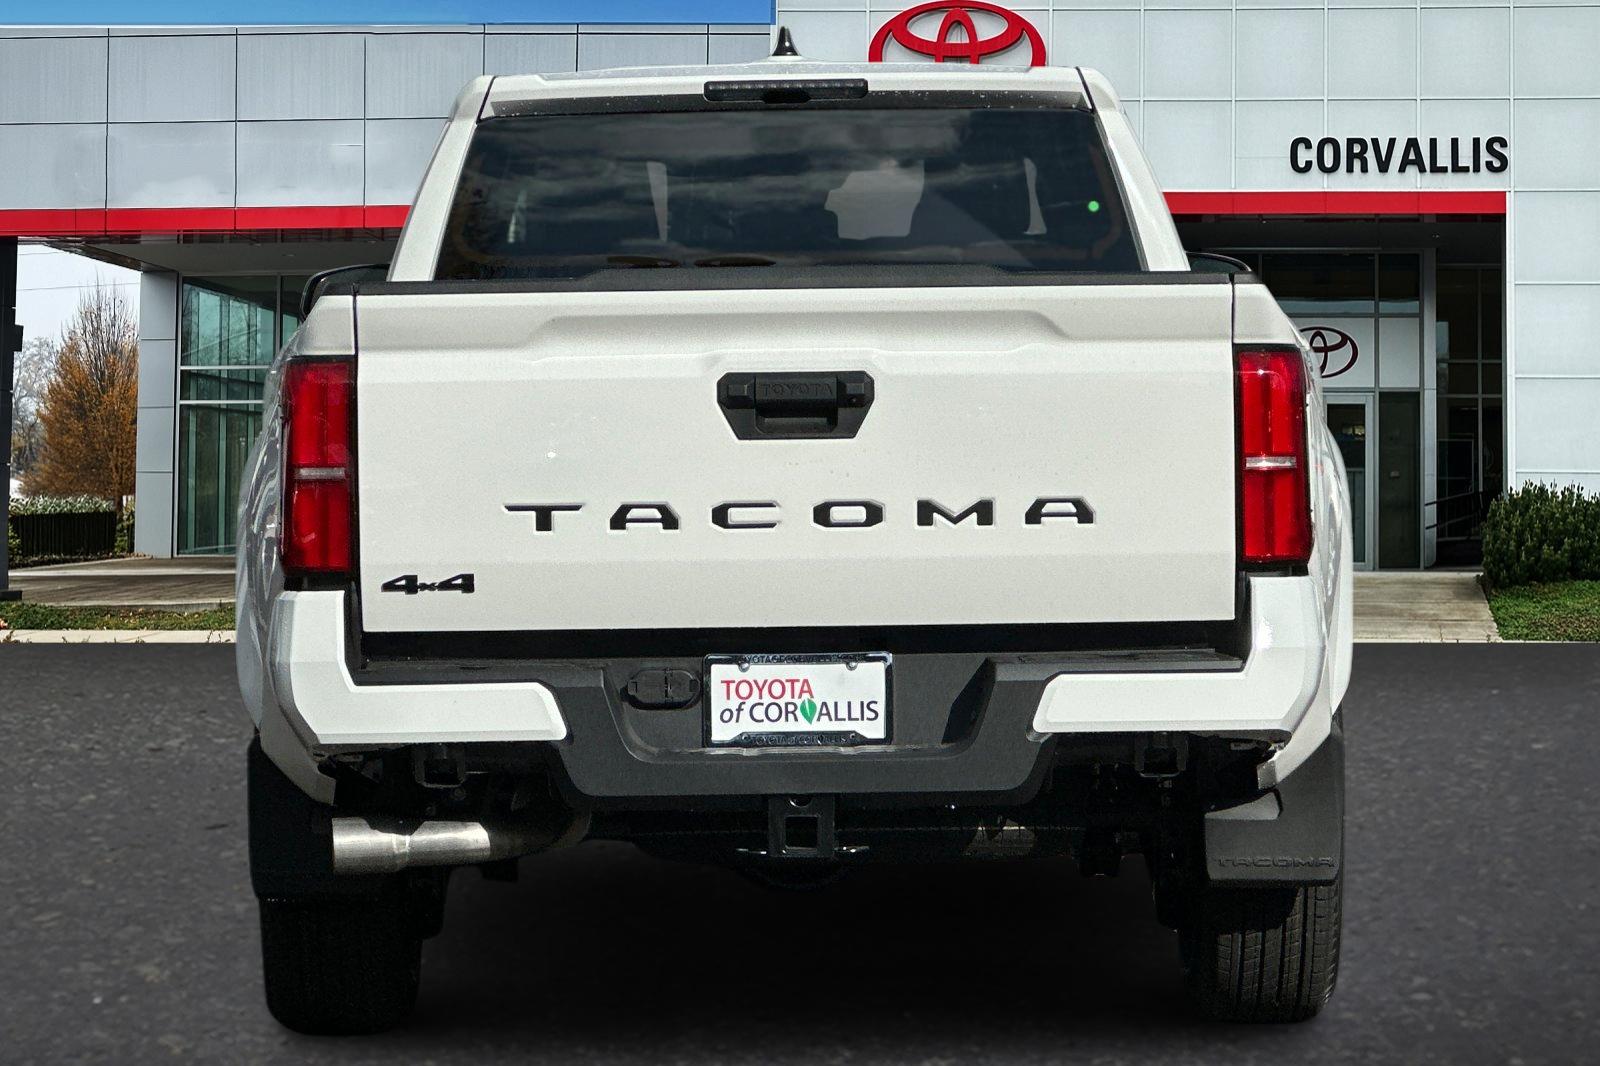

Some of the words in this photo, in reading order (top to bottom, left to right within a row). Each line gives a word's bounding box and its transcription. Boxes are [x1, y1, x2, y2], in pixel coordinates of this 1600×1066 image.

[1289, 136, 1509, 174] CORVALLIS
[762, 383, 834, 396] TOYOTA
[503, 497, 1096, 533] TACOMA
[720, 679, 814, 701] TOYOTA
[719, 701, 746, 724] of
[752, 734, 786, 745] TOYOTA
[1219, 856, 1335, 868] TACOMA
